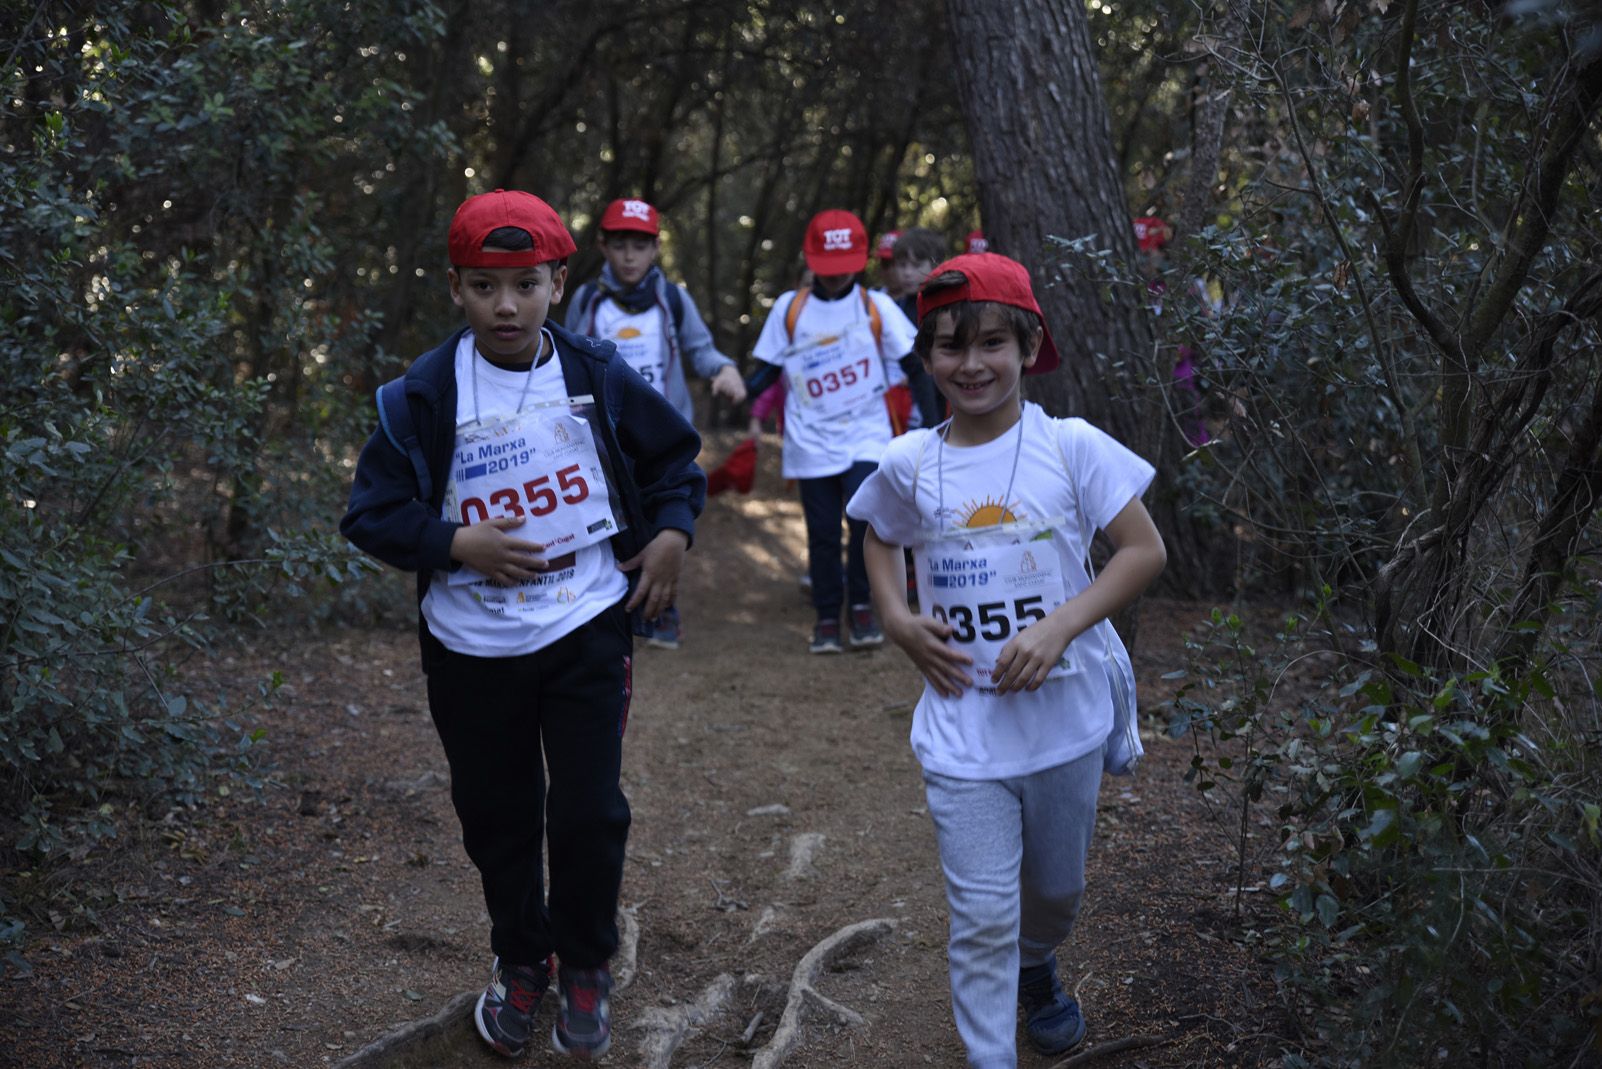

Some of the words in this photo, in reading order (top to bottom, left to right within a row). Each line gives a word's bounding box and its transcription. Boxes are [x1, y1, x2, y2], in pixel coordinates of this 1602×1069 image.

[824, 228, 851, 243] TOT
[807, 356, 871, 398] 0357
[478, 438, 526, 459] Marxa
[460, 463, 590, 526] 0355
[942, 558, 988, 572] Marxa
